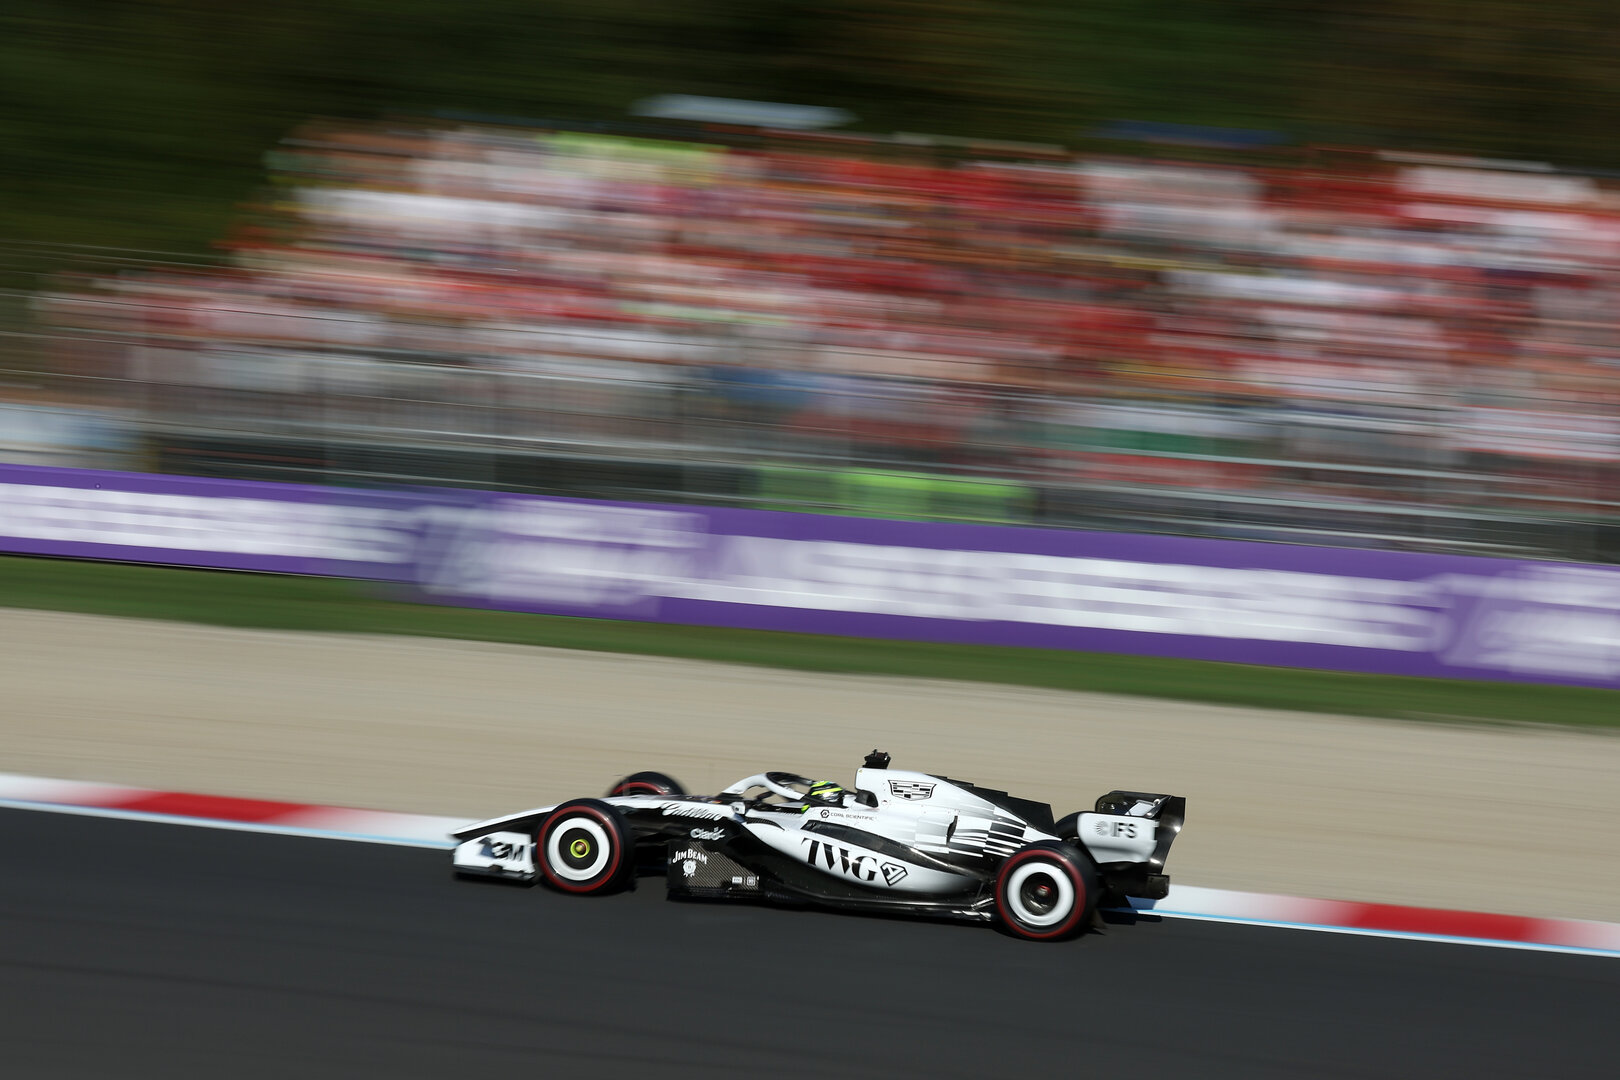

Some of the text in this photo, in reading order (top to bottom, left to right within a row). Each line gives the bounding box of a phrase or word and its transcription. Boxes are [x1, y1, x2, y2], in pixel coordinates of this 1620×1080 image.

[1110, 821, 1138, 839] IFS
[672, 848, 708, 865] JIM BEAM
[801, 837, 878, 881] TWG
